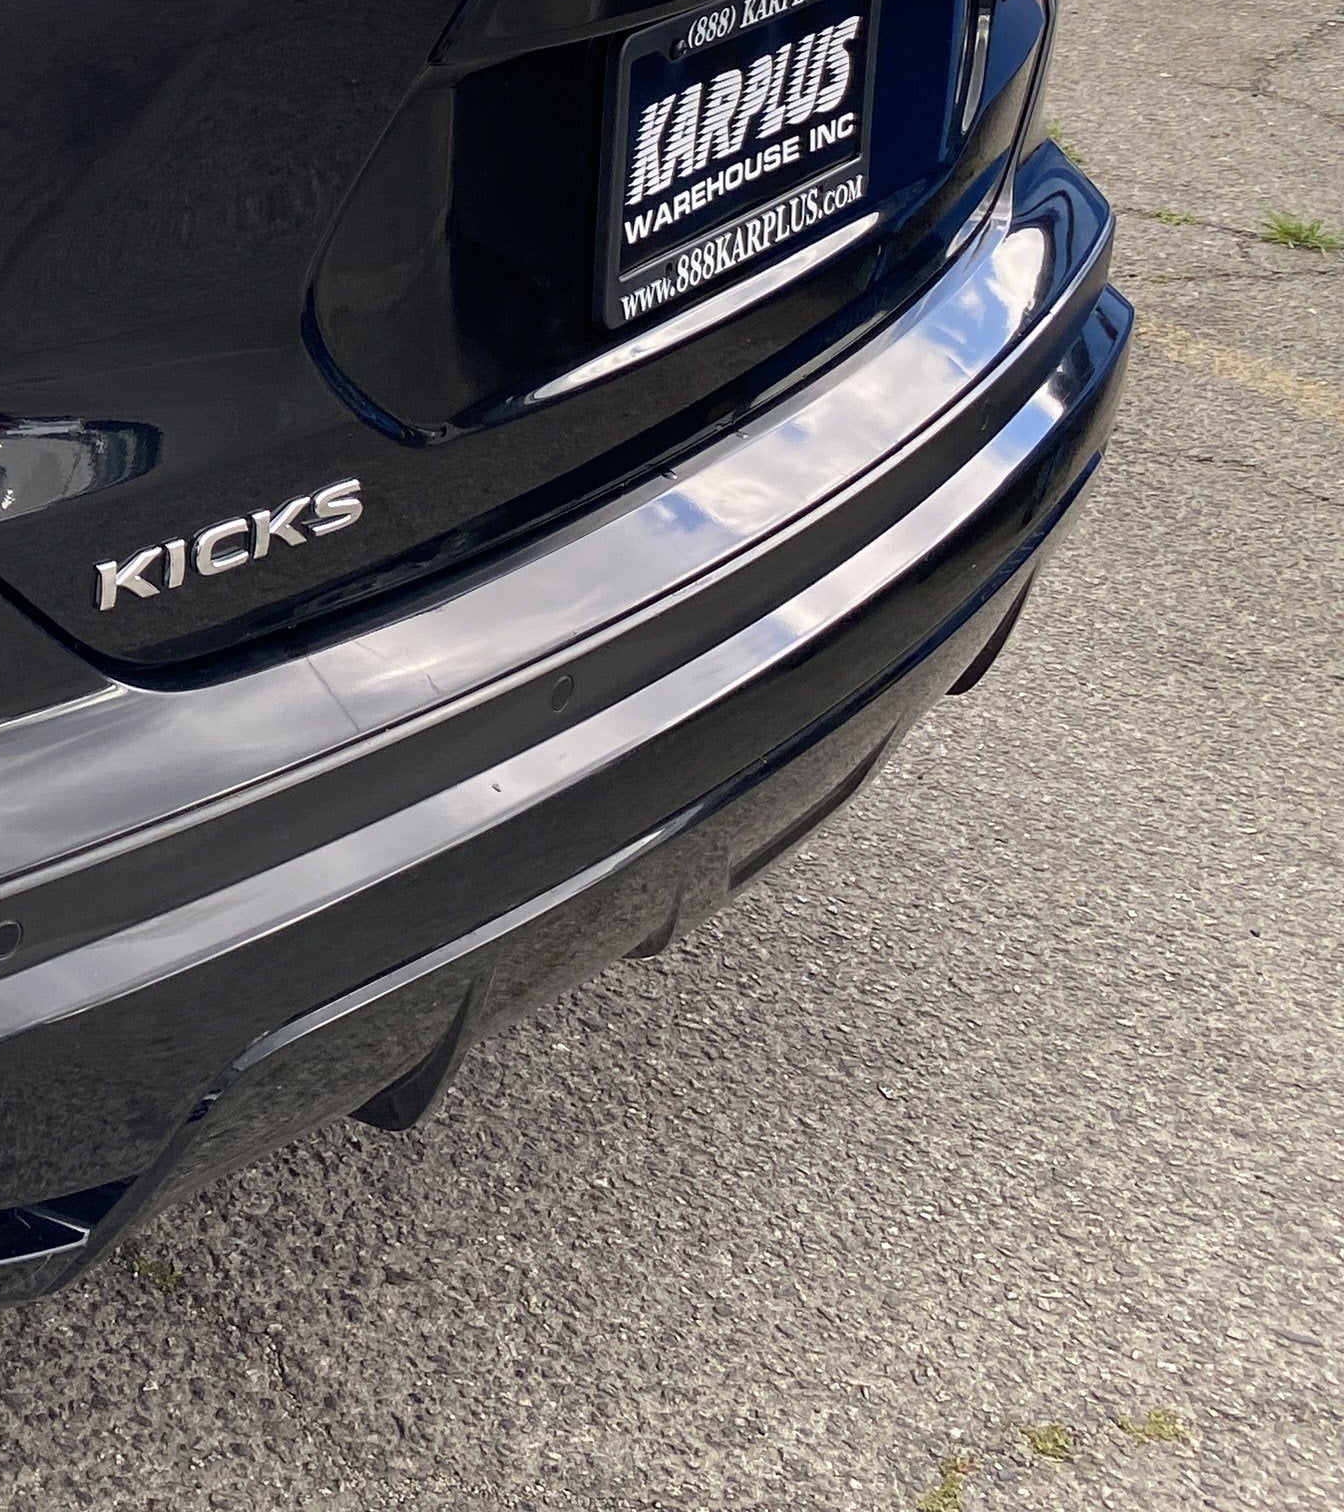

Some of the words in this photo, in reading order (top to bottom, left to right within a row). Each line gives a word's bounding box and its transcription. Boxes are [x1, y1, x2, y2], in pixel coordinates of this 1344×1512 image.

[688, 4, 736, 50] (888)
[624, 15, 861, 206] KARPLUS
[625, 135, 800, 245] WAREHOUSE
[810, 112, 856, 152] INC
[96, 477, 364, 611] KICKS
